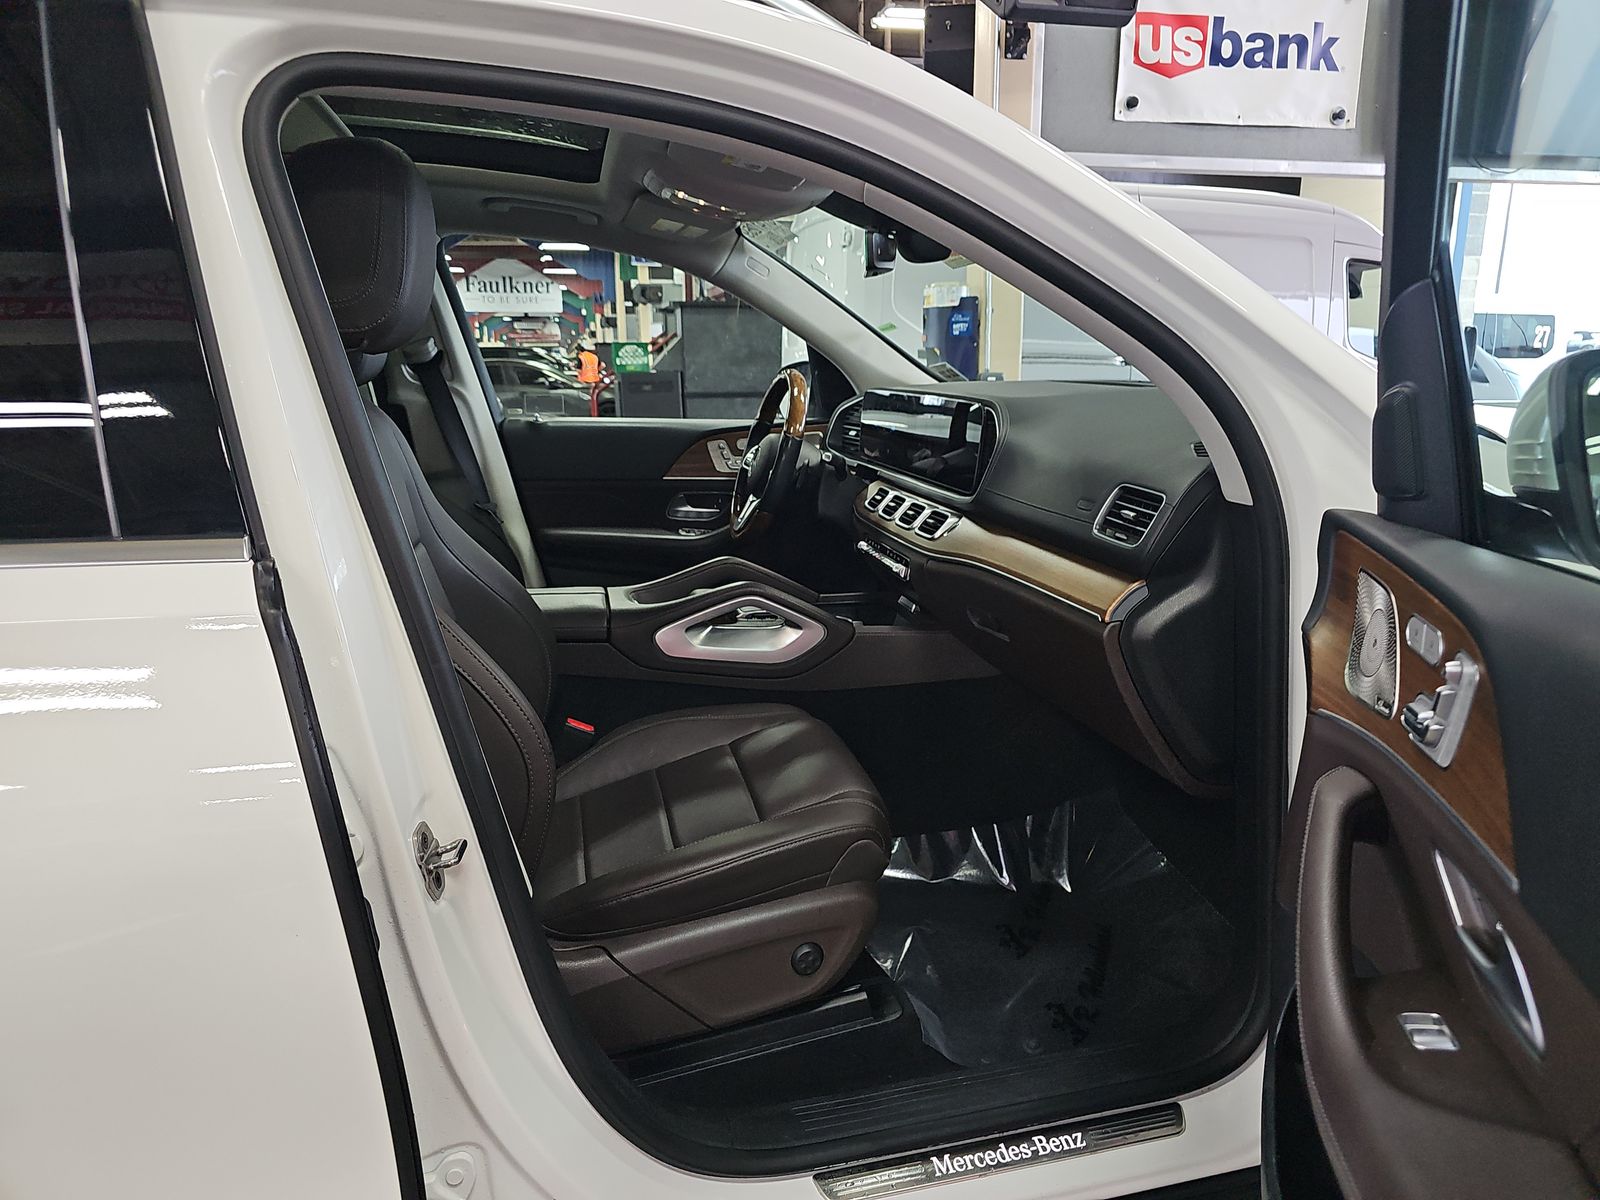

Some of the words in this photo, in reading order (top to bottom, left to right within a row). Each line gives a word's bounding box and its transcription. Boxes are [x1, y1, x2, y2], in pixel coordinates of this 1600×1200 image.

[464, 274, 554, 294] Faulkner
[482, 295, 496, 304] TO
[500, 295, 510, 304] BE
[516, 295, 539, 304] SURE
[1533, 325, 1551, 348] 27
[929, 1131, 1087, 1177] Mercedes-Benz
